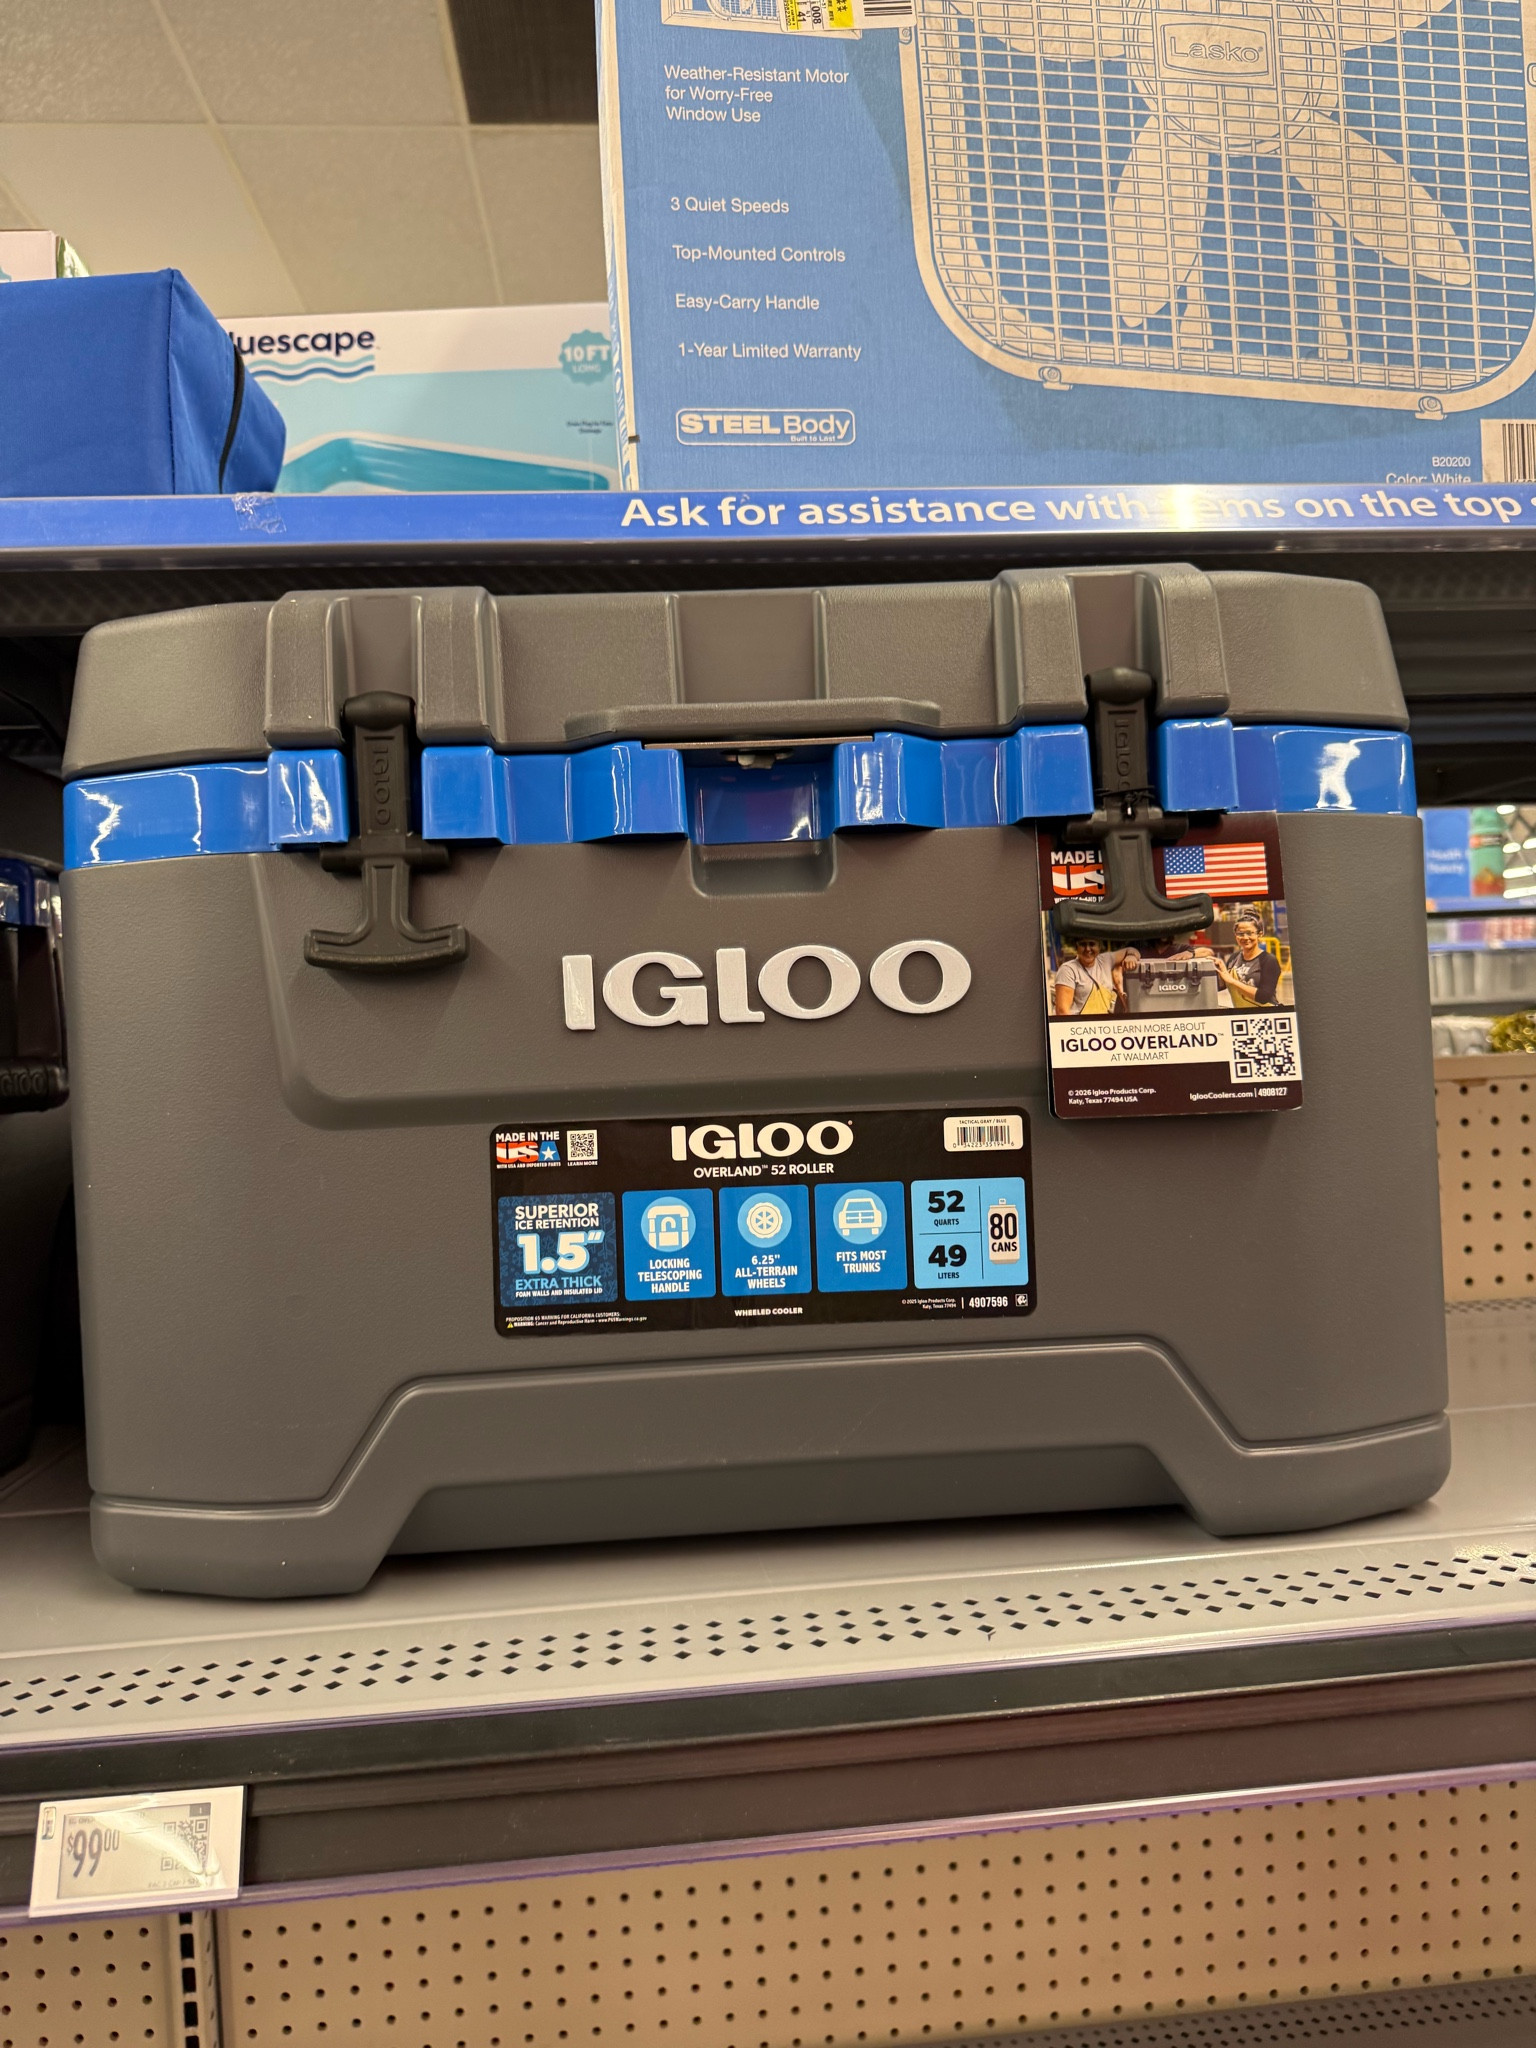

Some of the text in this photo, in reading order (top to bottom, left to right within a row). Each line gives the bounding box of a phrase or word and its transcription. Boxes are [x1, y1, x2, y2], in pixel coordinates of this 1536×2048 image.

[811, 6, 822, 24] 008
[1170, 36, 1260, 63] Lasko
[664, 64, 849, 84] Weather-Resistant Motor
[665, 86, 773, 104] for Worry-Free
[666, 106, 761, 122] Window Use
[670, 197, 790, 215] 3 Quiet Speeds
[672, 244, 846, 264] Top-Mounted Controls
[676, 294, 820, 312] Easy-Carry Handle
[229, 330, 375, 357] luescape
[564, 344, 610, 362] 10 FT
[678, 342, 862, 362] 1-Year Limited Warranty
[680, 414, 850, 439] STEEL Body
[1432, 456, 1471, 467] B20200
[1431, 473, 1471, 484] White
[621, 497, 709, 527] Ask
[718, 497, 785, 526] for
[798, 496, 1036, 525] assistance
[1045, 492, 1149, 520] with
[1295, 494, 1355, 518] on
[1360, 490, 1438, 517] the
[1443, 492, 1522, 523] top
[372, 748, 391, 826] IGLOO
[1051, 850, 1102, 864] MADE I
[1052, 864, 1105, 896] US
[562, 940, 972, 1030] IGLOO
[1070, 1022, 1206, 1035] SCAN TO LEARN MORE ABOUT
[1061, 1037, 1116, 1052] IGLOO
[1111, 1052, 1169, 1062] AT WALMART
[1190, 1087, 1287, 1101] IglooCoolers.com 4908127
[496, 1131, 560, 1142] MADE IN THE
[671, 1120, 854, 1161] IGLOO
[496, 1141, 560, 1164] USA
[771, 1165, 786, 1175] 52
[789, 1162, 834, 1174] ROLLER
[928, 1190, 965, 1214] 52
[515, 1203, 599, 1220] SUPERIOR
[515, 1217, 599, 1230] ICE RETENTION
[934, 1218, 960, 1227] QUARTS
[990, 1212, 1017, 1240] 80
[992, 1242, 1017, 1252] CANS
[836, 1250, 886, 1262] FITS MOST
[928, 1244, 967, 1267] 49
[649, 1258, 690, 1269] LOCKING
[843, 1262, 881, 1274] TRUNKS
[638, 1270, 702, 1282] TELESCOPING
[735, 1266, 798, 1278] ALL-TERRAIN
[515, 1276, 602, 1290] EXTRA THICK
[652, 1282, 690, 1293] HANDLE
[747, 1279, 786, 1289] WHEELS
[969, 1296, 1008, 1308] 4907596
[734, 1307, 803, 1317] WHEELED COOLER
